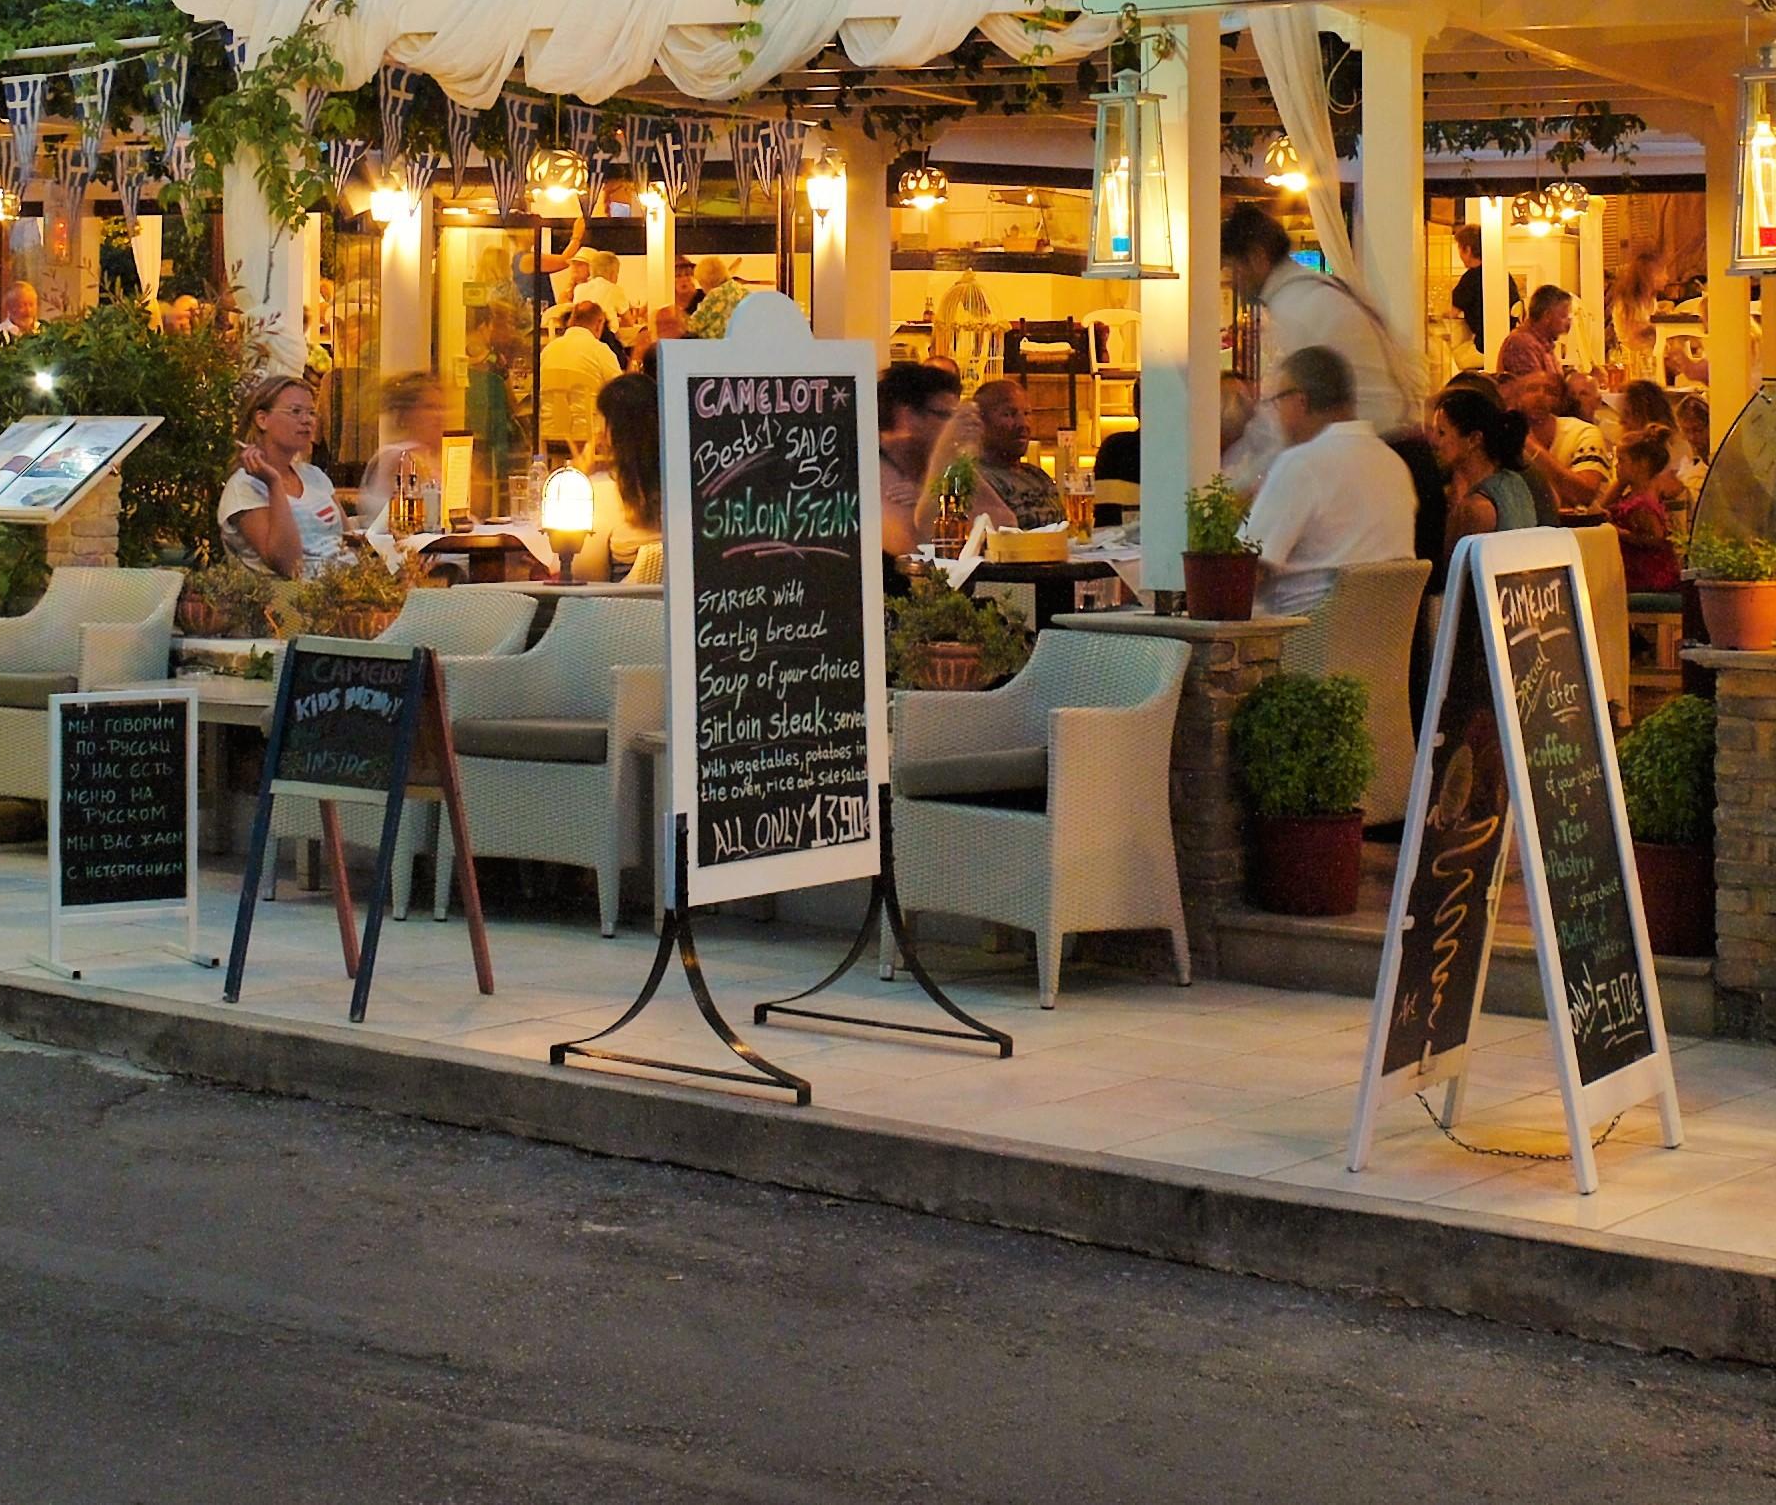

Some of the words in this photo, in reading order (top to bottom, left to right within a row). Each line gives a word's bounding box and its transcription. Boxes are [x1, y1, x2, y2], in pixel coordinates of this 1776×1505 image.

[695, 378, 829, 419] CAMELOT
[694, 417, 758, 486] Best
[702, 486, 791, 540] SIRLOIN
[793, 492, 859, 541] STEAK
[697, 585, 767, 615] STARTER
[765, 610, 828, 642] bread
[699, 663, 748, 710] Soup
[756, 660, 777, 691] of
[779, 668, 809, 700] your
[811, 653, 861, 682] choice
[294, 687, 341, 722] KIDS
[68, 718, 94, 734] МЫ
[104, 717, 175, 734] ГОВОРИМ
[70, 763, 80, 781] У
[92, 762, 123, 779] НАС
[129, 762, 173, 778] ЕСТЬ
[804, 741, 852, 775] potatoes
[855, 740, 867, 756] in
[66, 789, 116, 805] МЕНЮ
[131, 786, 154, 801] НА
[701, 782, 728, 803] the
[766, 776, 795, 792] rice
[797, 771, 816, 791] and
[82, 805, 166, 823] РУССКОМ
[66, 836, 94, 851] МЫ
[100, 834, 133, 850] ВАС
[712, 815, 749, 863] ALL
[754, 802, 806, 849] ONLY
[66, 866, 78, 880] С
[85, 862, 183, 879] НЕТЕРПЕНИЕМ
